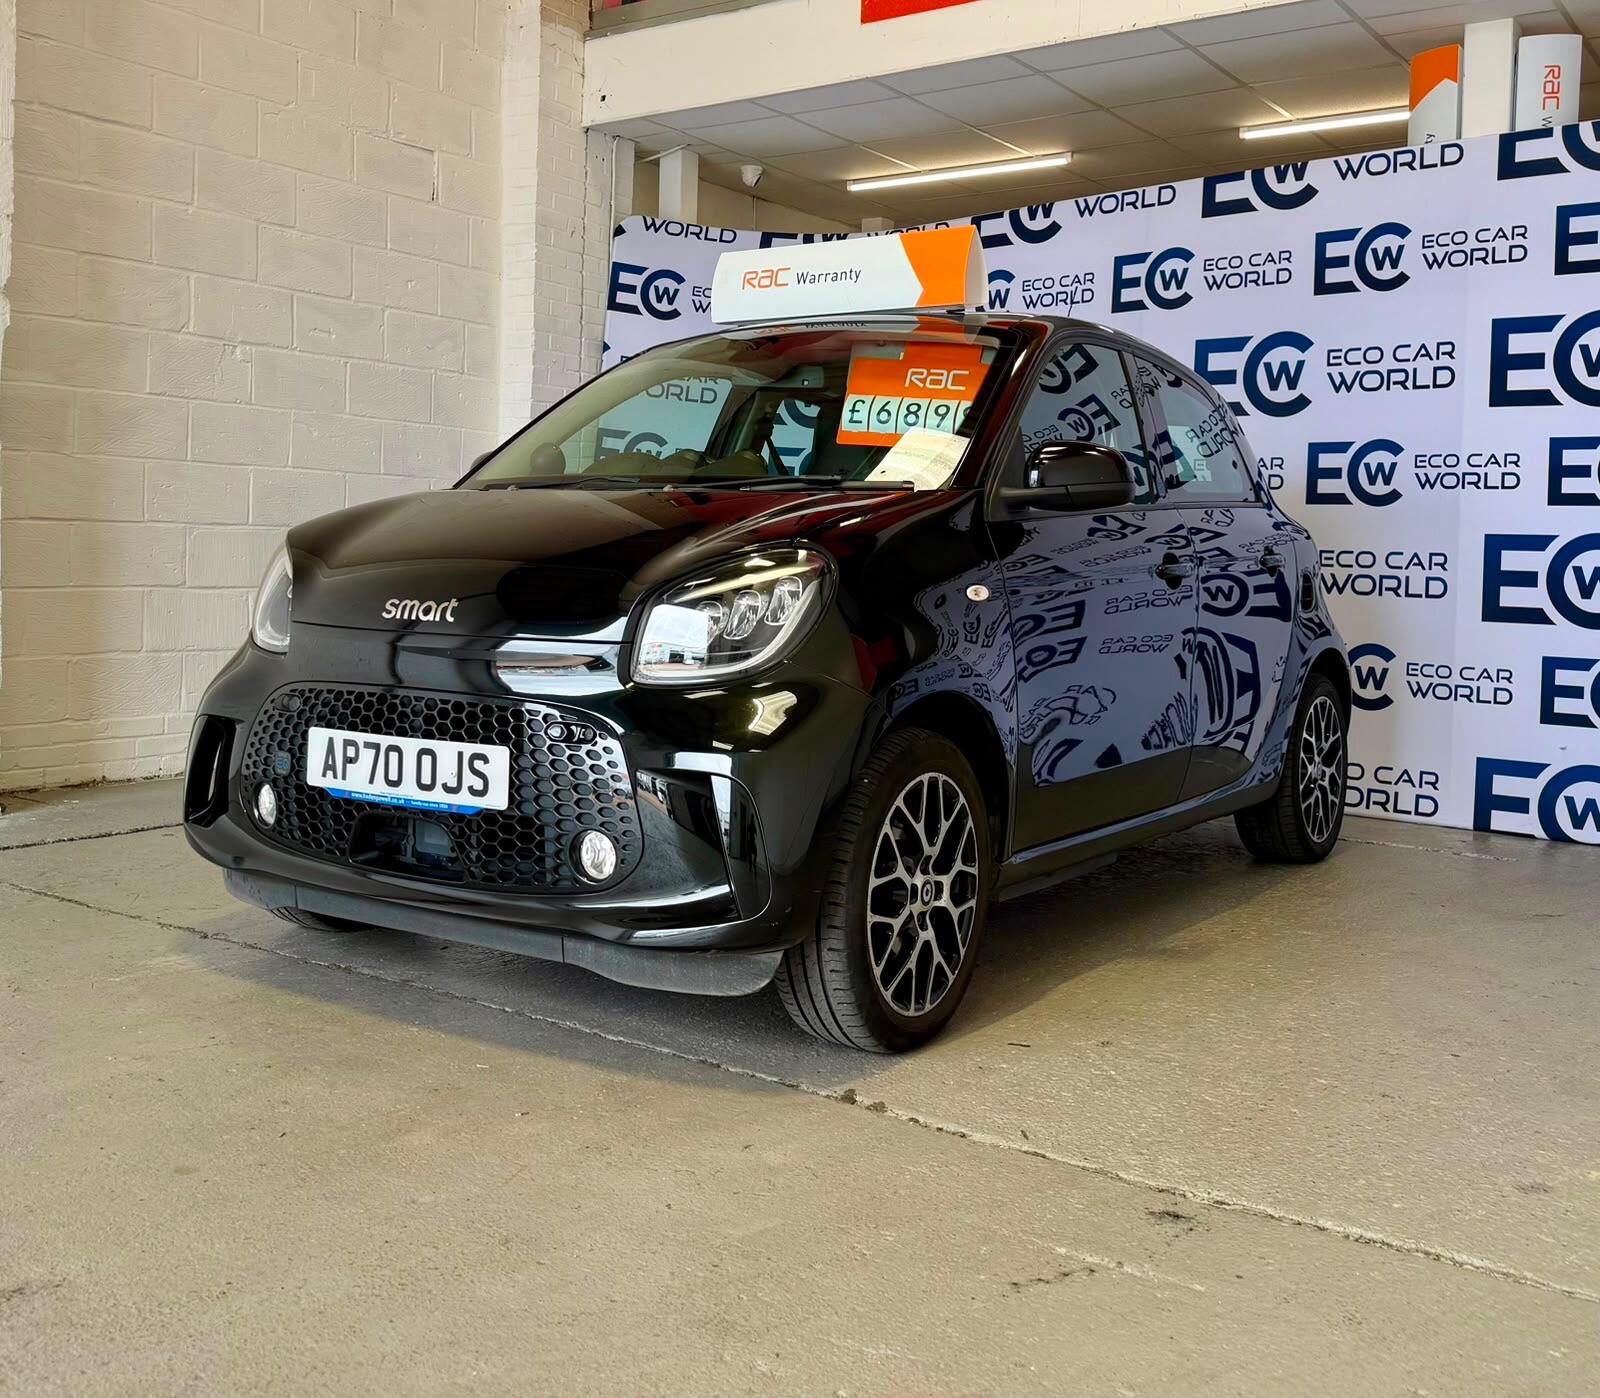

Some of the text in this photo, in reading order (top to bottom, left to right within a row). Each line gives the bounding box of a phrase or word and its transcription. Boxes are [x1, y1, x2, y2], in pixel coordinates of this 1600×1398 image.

[1333, 142, 1464, 181] WORLD
[1075, 185, 1176, 218] WORLD
[642, 215, 737, 244] WORLD
[1422, 224, 1528, 249] ECO CAR
[1203, 250, 1292, 272] ECO CAR
[1422, 244, 1528, 270] WORLD
[796, 267, 862, 286] Warranty
[1022, 272, 1094, 292] ECO CAR
[1203, 268, 1292, 291] WORLD
[692, 286, 712, 299] EC
[1022, 287, 1094, 309] WORLD
[1326, 340, 1456, 366] ECO CAR
[1326, 365, 1456, 393] WORLD
[646, 382, 718, 404] ORLD
[1258, 456, 1284, 470] AR
[1414, 453, 1521, 468] ECO CAR
[1414, 471, 1521, 490] WORLD
[1319, 550, 1448, 571] ECO CAR
[1320, 573, 1448, 599] WORLD
[382, 598, 459, 622] smart
[1406, 662, 1513, 684] ECO CAR
[1406, 680, 1513, 706] WORLD
[321, 737, 404, 788] AP70
[1374, 766, 1440, 791] CAR
[1343, 785, 1439, 818] ORLD
